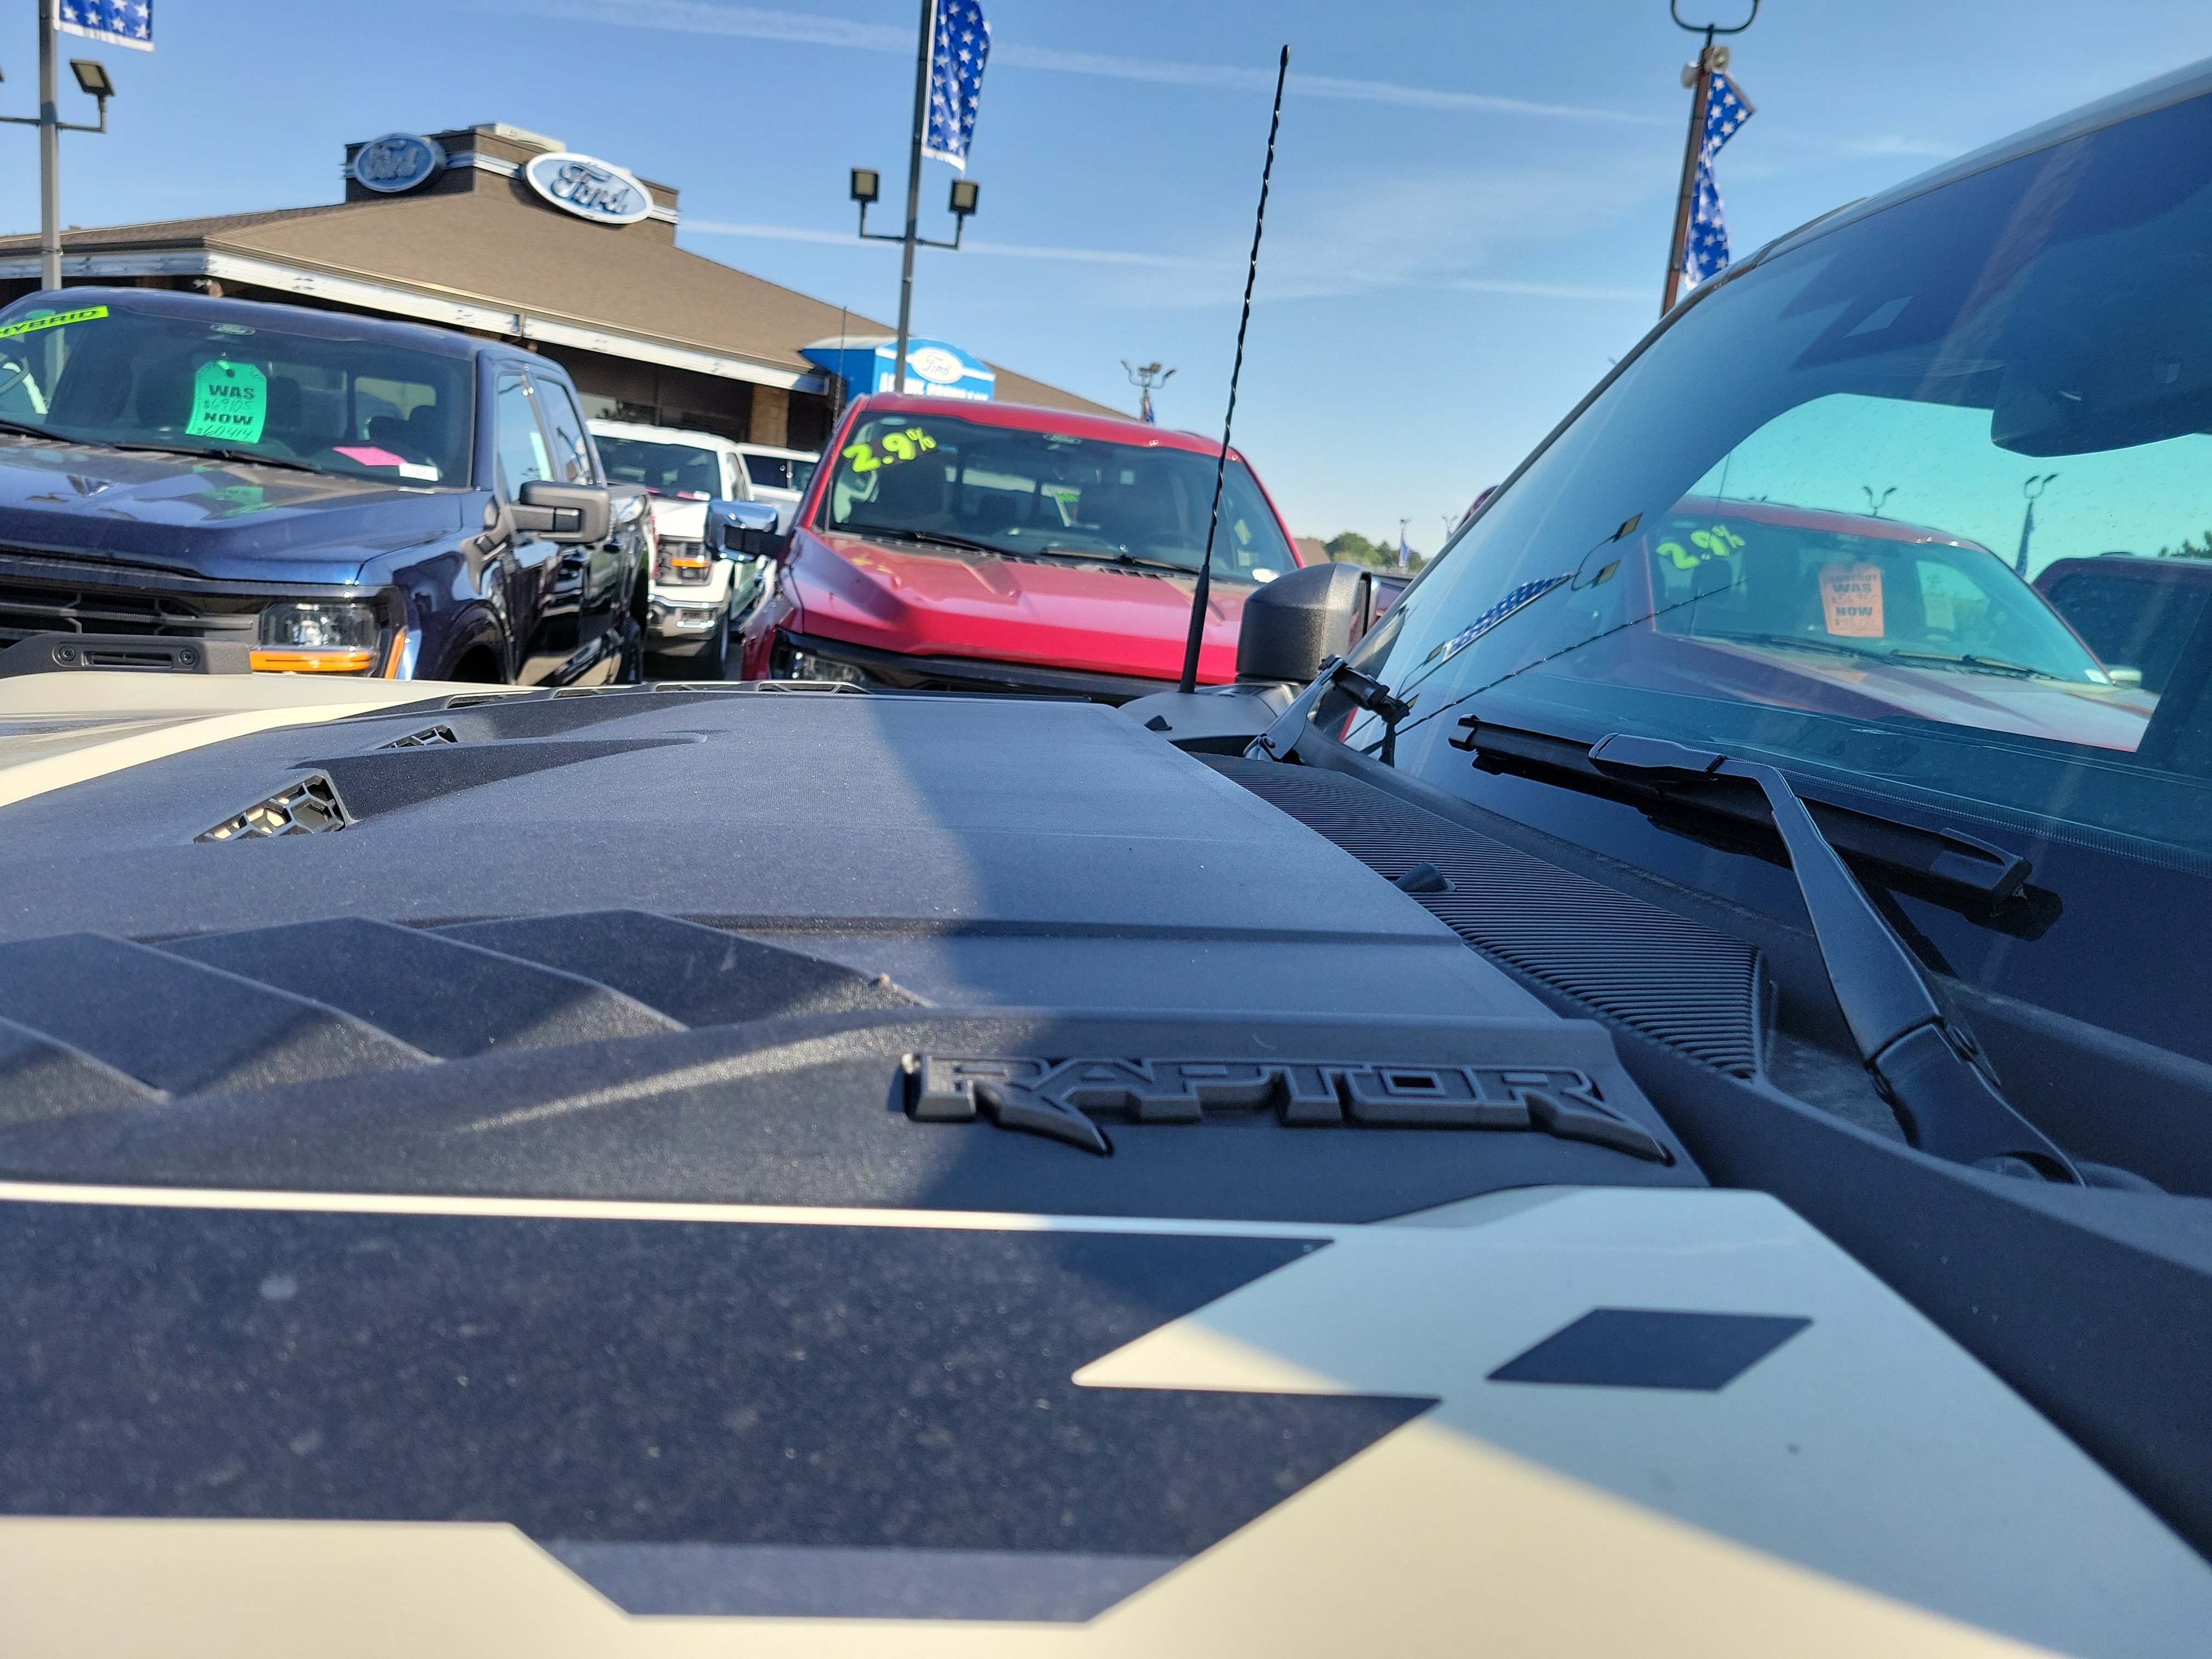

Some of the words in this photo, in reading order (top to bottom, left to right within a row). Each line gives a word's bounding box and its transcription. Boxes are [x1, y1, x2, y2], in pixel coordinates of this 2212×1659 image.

[364, 140, 417, 179] Ford
[550, 163, 629, 213] Ford
[922, 355, 951, 376] Ford
[209, 385, 255, 399] WAS
[204, 412, 254, 426] NOW
[842, 427, 936, 472] 2.9%
[1656, 523, 1745, 569] 2.9%
[1836, 607, 1872, 617] NOW
[901, 1052, 1677, 1167] RAPTOR
